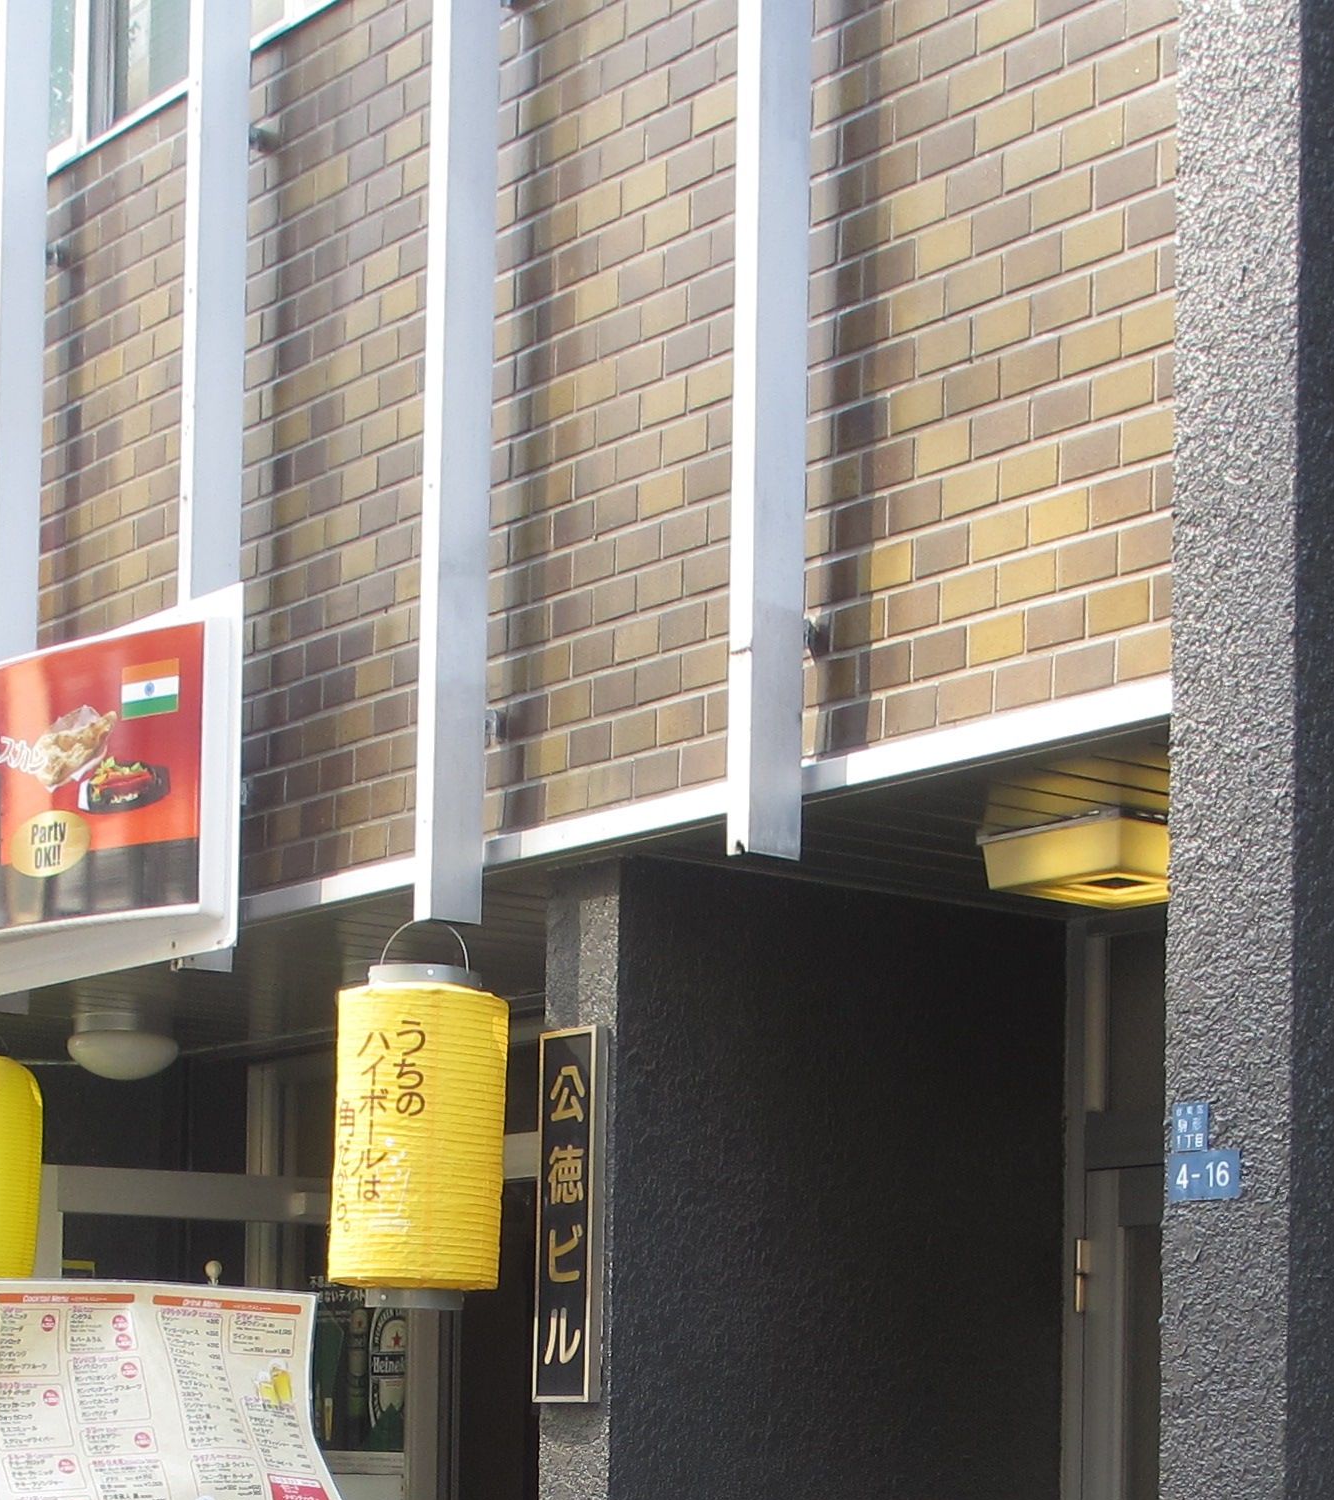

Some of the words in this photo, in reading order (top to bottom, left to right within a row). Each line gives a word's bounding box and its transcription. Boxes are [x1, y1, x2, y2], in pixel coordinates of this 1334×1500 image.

[30, 821, 67, 845] Party
[34, 846, 62, 870] OK!!
[394, 1020, 427, 1117] うちの
[351, 1030, 392, 1203] ハイボールは
[1175, 1161, 1230, 1189] 4-16
[544, 1065, 585, 1366] 公徳ビル
